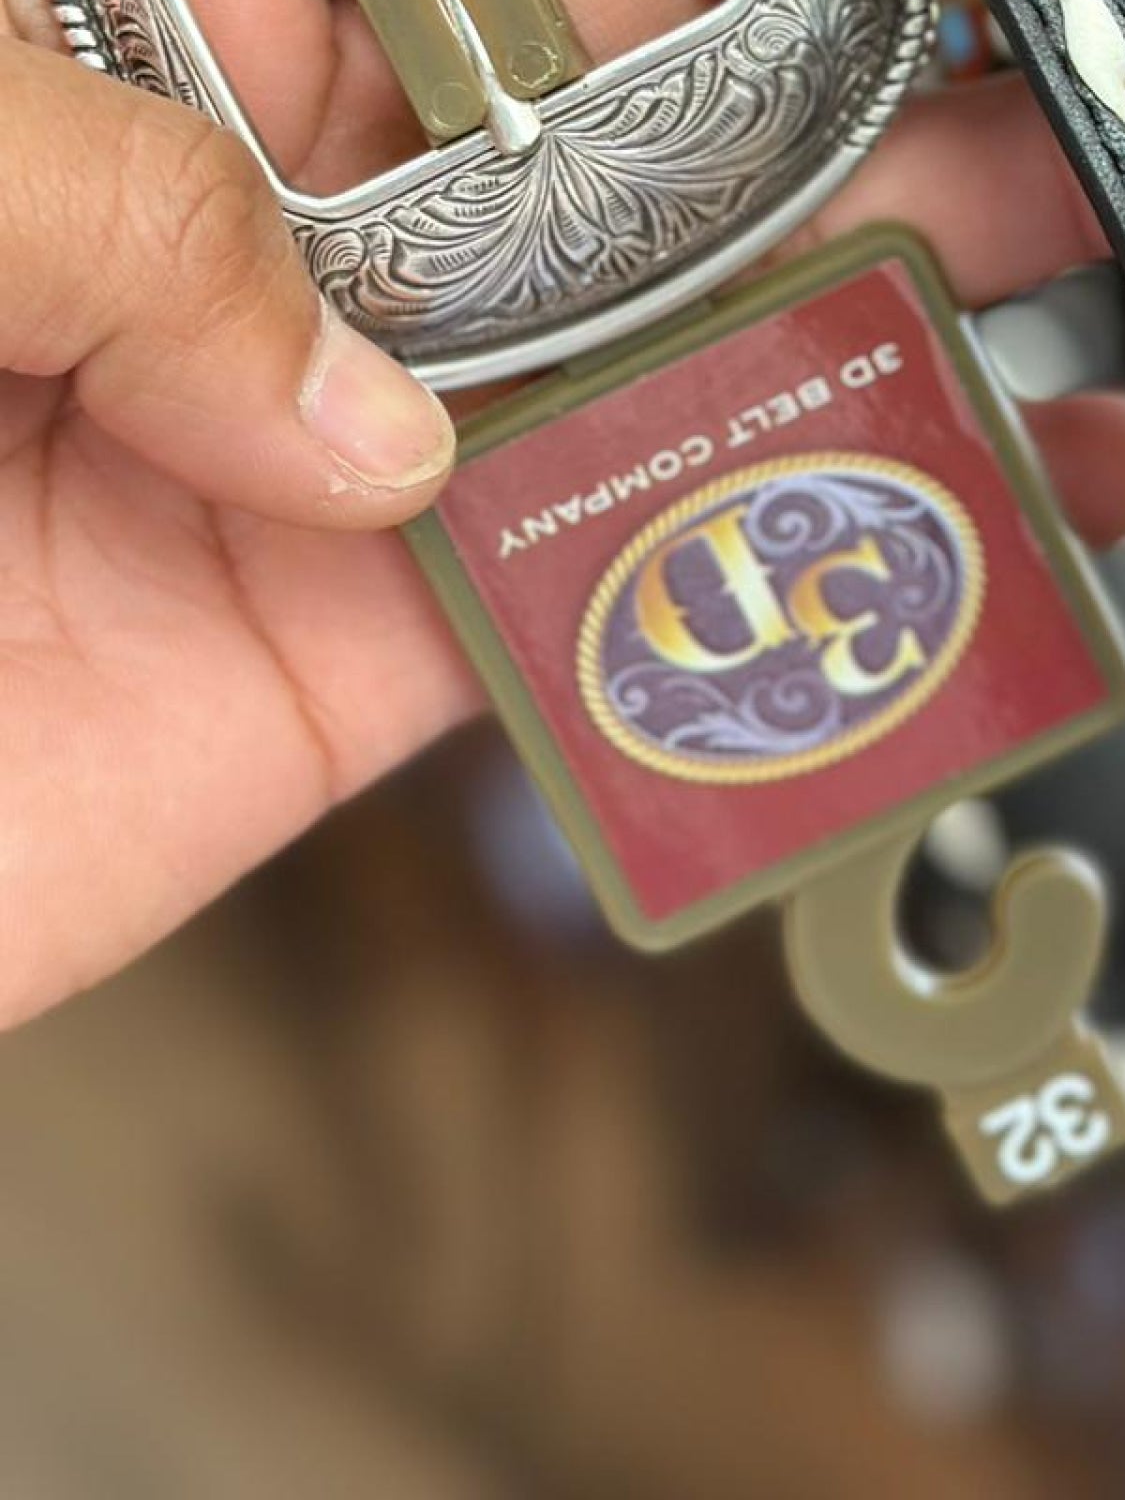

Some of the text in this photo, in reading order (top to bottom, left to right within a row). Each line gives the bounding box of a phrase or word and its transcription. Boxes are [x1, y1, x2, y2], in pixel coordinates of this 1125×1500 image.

[499, 342, 903, 559] 3D BELT COMPANY
[634, 503, 925, 696] 3D
[979, 1073, 1109, 1183] 32
